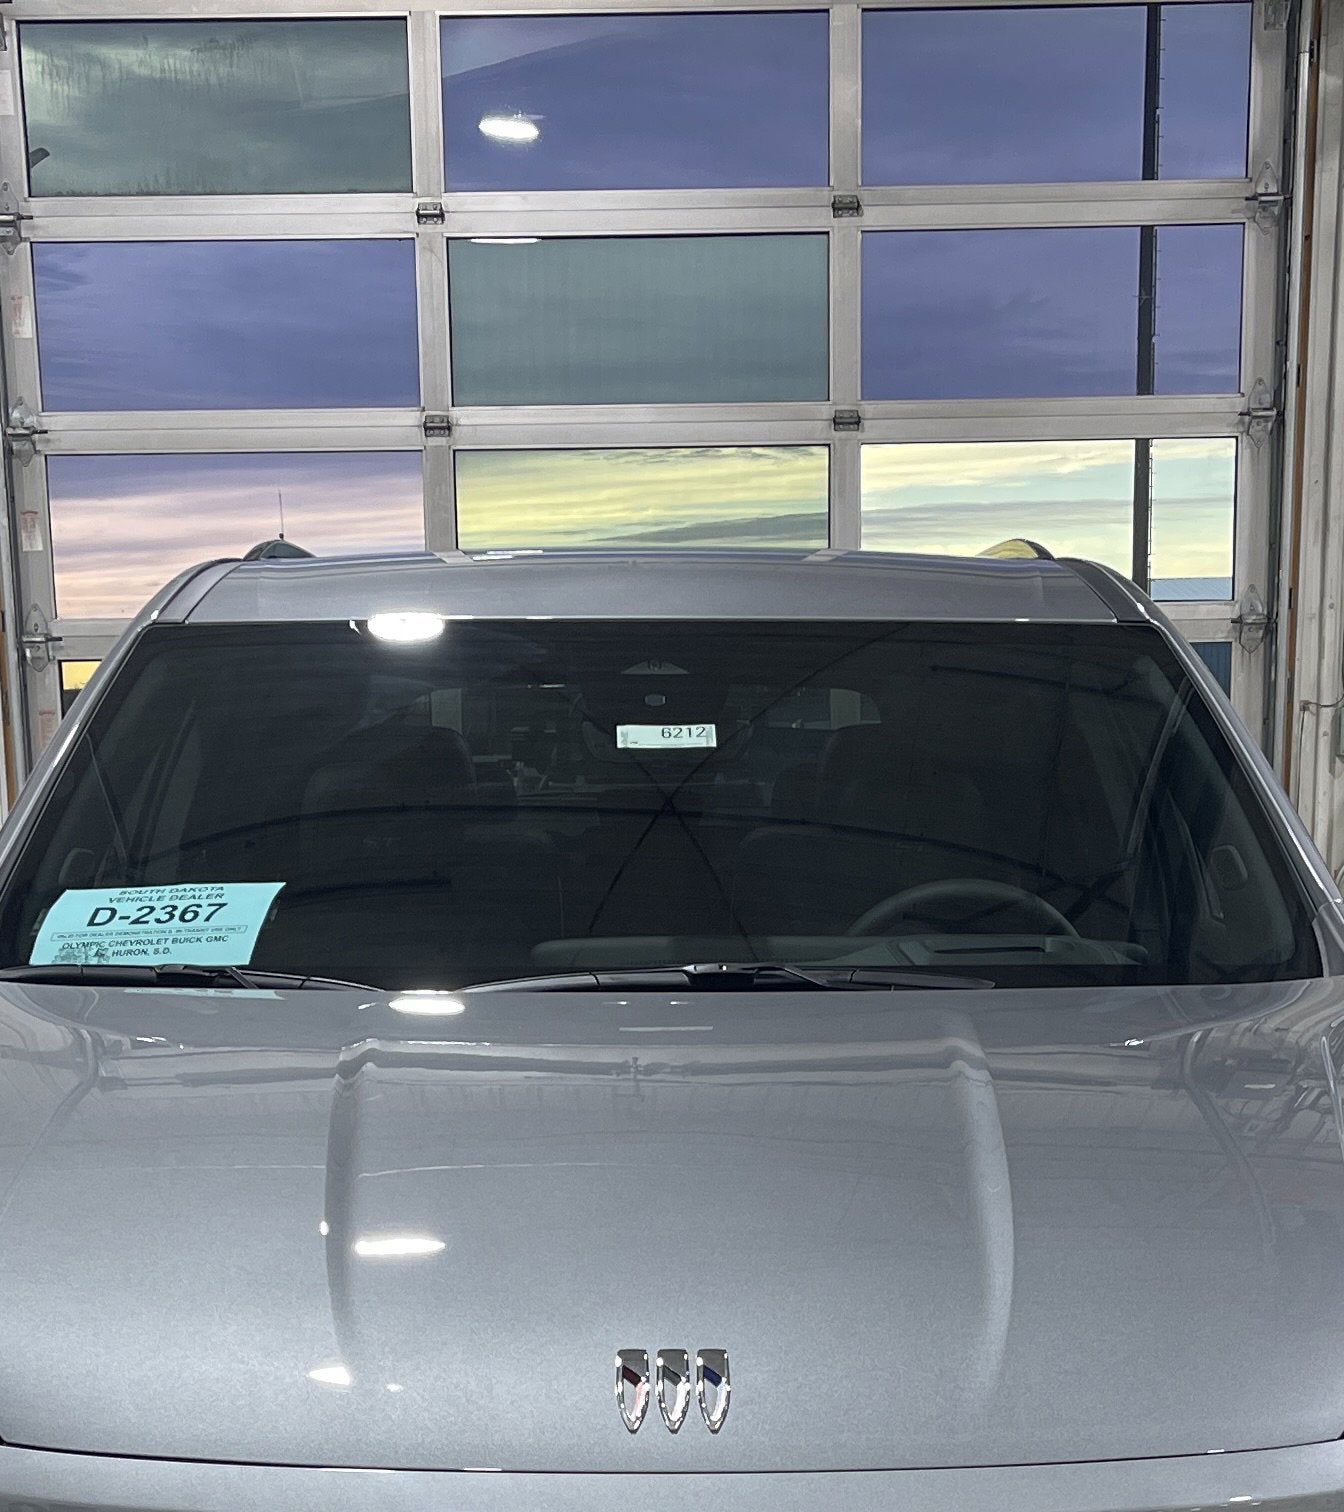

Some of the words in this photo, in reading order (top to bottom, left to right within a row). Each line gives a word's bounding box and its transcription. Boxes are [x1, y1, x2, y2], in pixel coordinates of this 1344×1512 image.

[661, 726, 706, 739] 6212
[109, 895, 166, 903] VEHICLE
[168, 893, 224, 901] DEALER
[86, 902, 228, 927] D-2367
[62, 940, 106, 949] OLYMPIC
[108, 937, 170, 947] CHEVROLET
[171, 936, 203, 945] BUICK
[205, 935, 229, 943] GMC
[111, 948, 149, 957] HURON,
